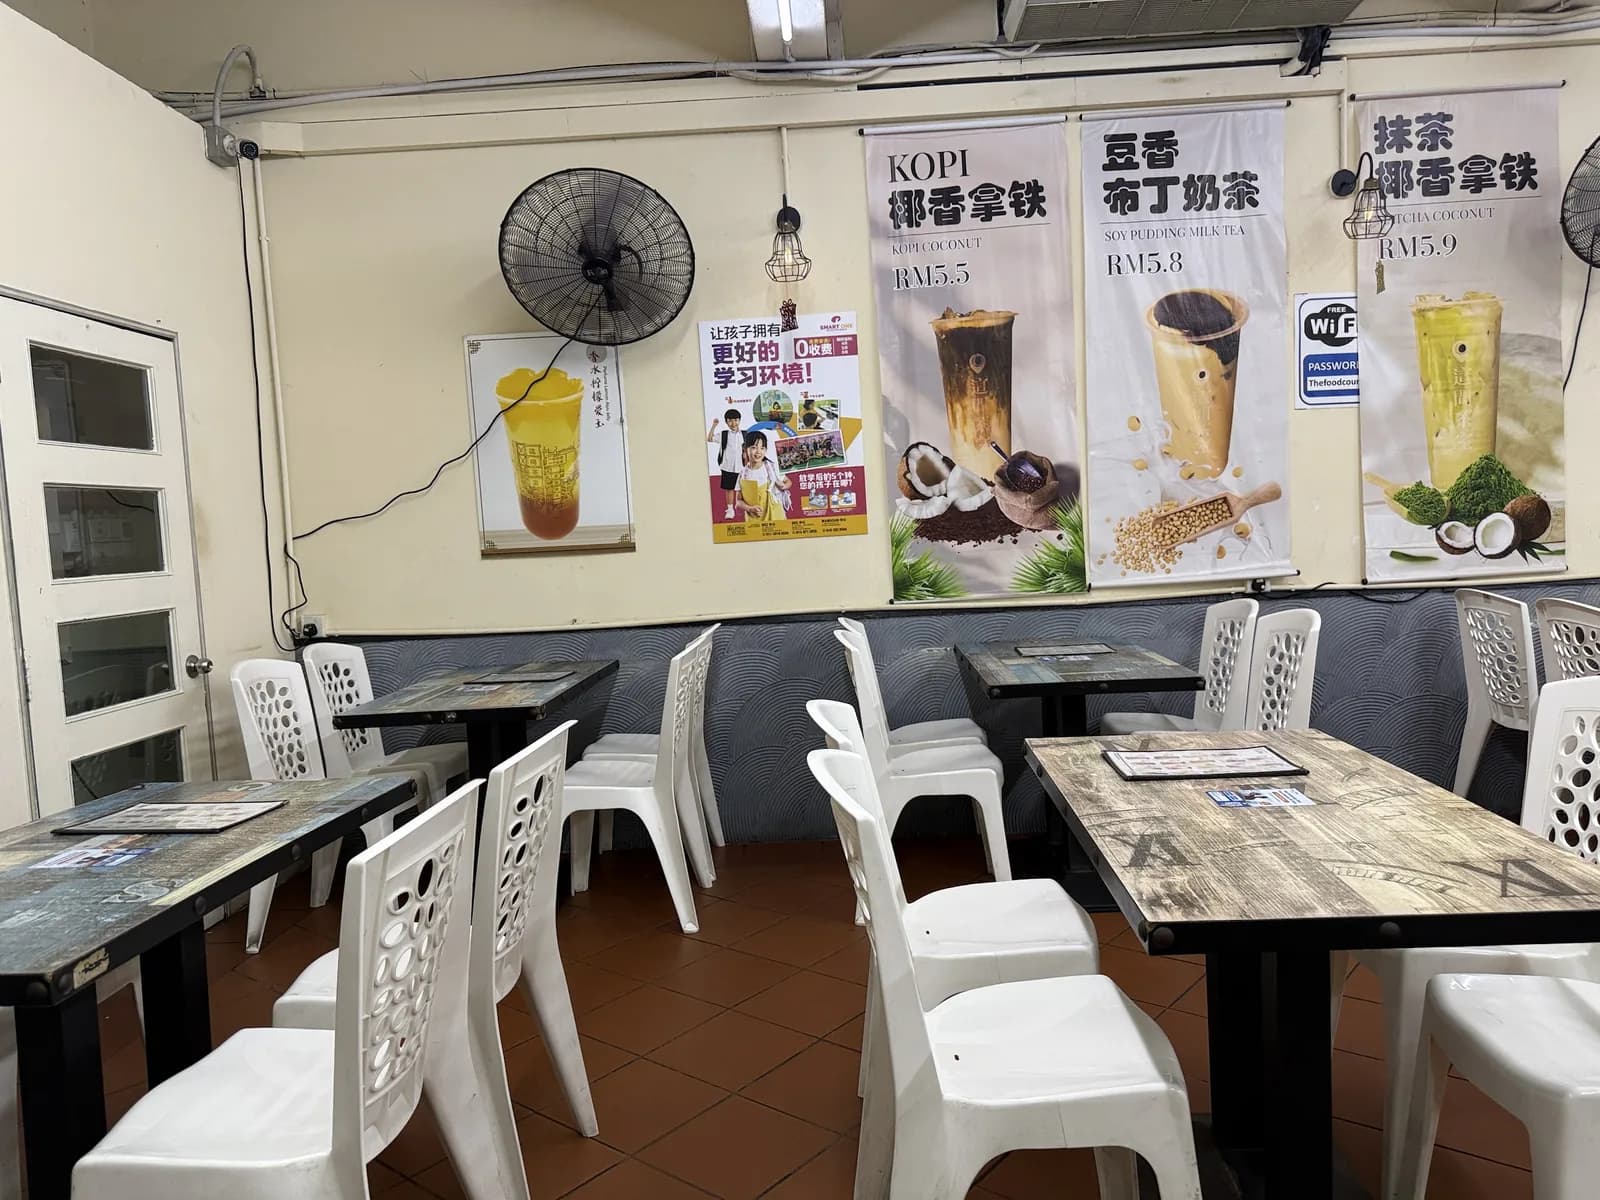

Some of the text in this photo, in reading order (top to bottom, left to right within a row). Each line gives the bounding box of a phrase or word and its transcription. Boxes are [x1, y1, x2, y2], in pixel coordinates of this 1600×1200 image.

[1374, 112, 1455, 154] 抹茶
[1102, 130, 1179, 171] 豆香
[888, 149, 970, 183] KOPI
[1375, 152, 1539, 200] 椰香拿铁
[888, 179, 1047, 229] 椰香拿铁
[1103, 171, 1260, 215] 布丁奶茶
[1389, 207, 1496, 224] TCHA COCONUT
[892, 237, 983, 255] KOPI COCONUT
[1105, 225, 1246, 242] SOY PUDDING MILK TEA
[1379, 234, 1457, 260] RM5.9
[893, 262, 970, 291] RM5.5
[1107, 252, 1183, 276] RM5.8
[710, 323, 781, 340] 让孩子拥有
[712, 340, 779, 365] 更好的
